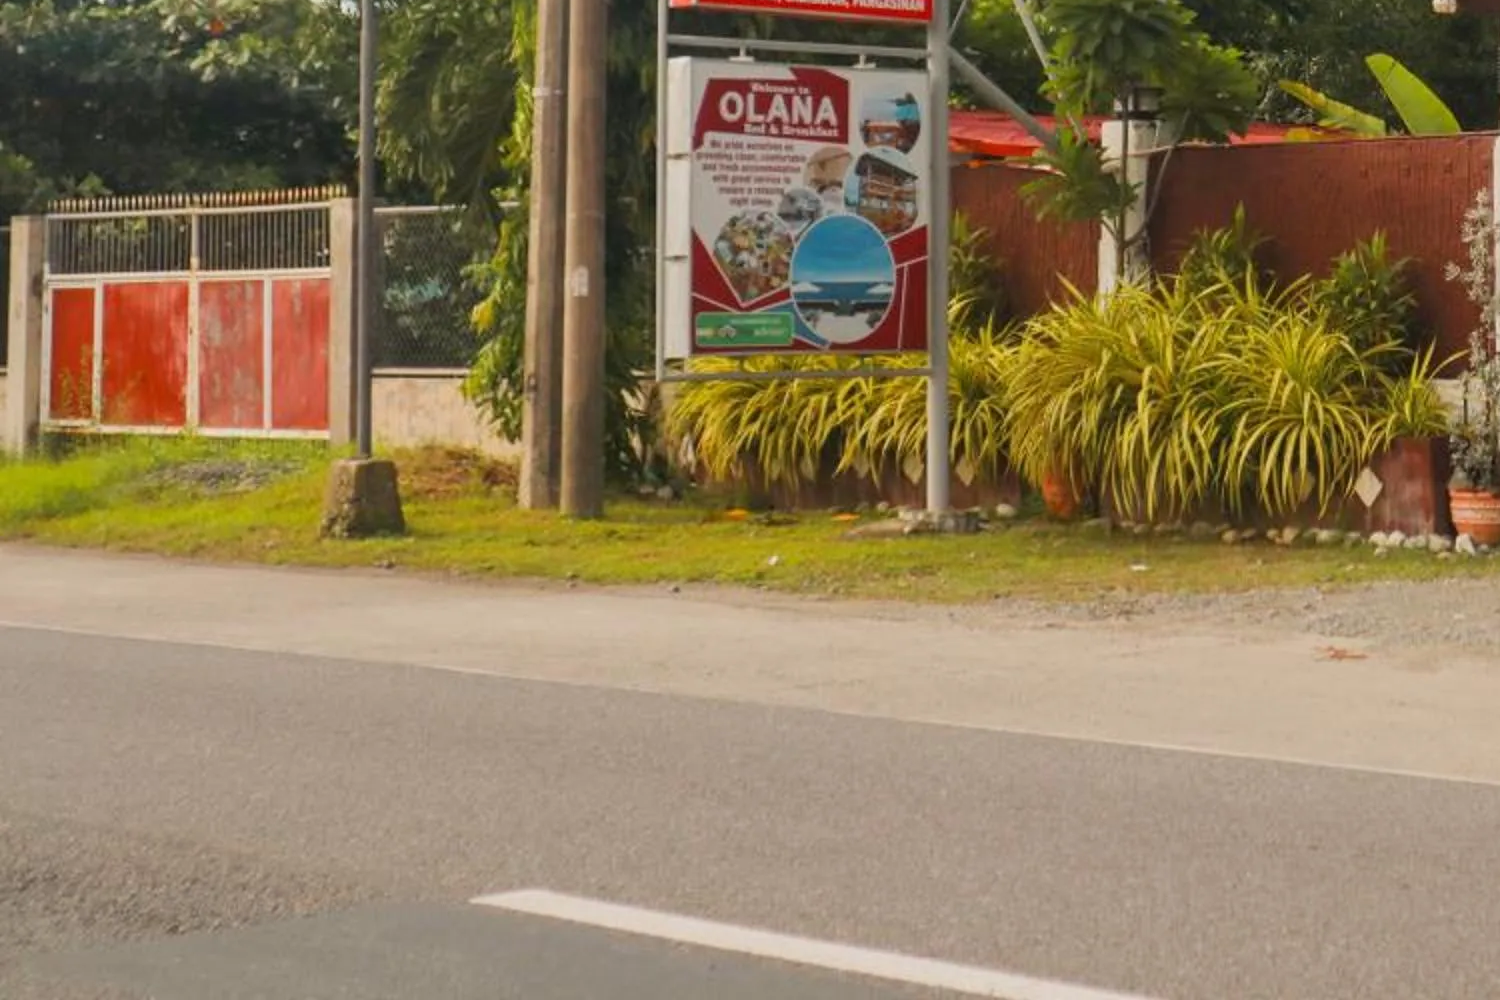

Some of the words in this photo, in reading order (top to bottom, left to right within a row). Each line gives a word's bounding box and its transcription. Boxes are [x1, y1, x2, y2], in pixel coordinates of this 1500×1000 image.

[751, 81, 796, 94] Welcome
[718, 90, 838, 127] OLANA
[744, 123, 765, 134] Bed
[782, 124, 839, 137] Breakfast
